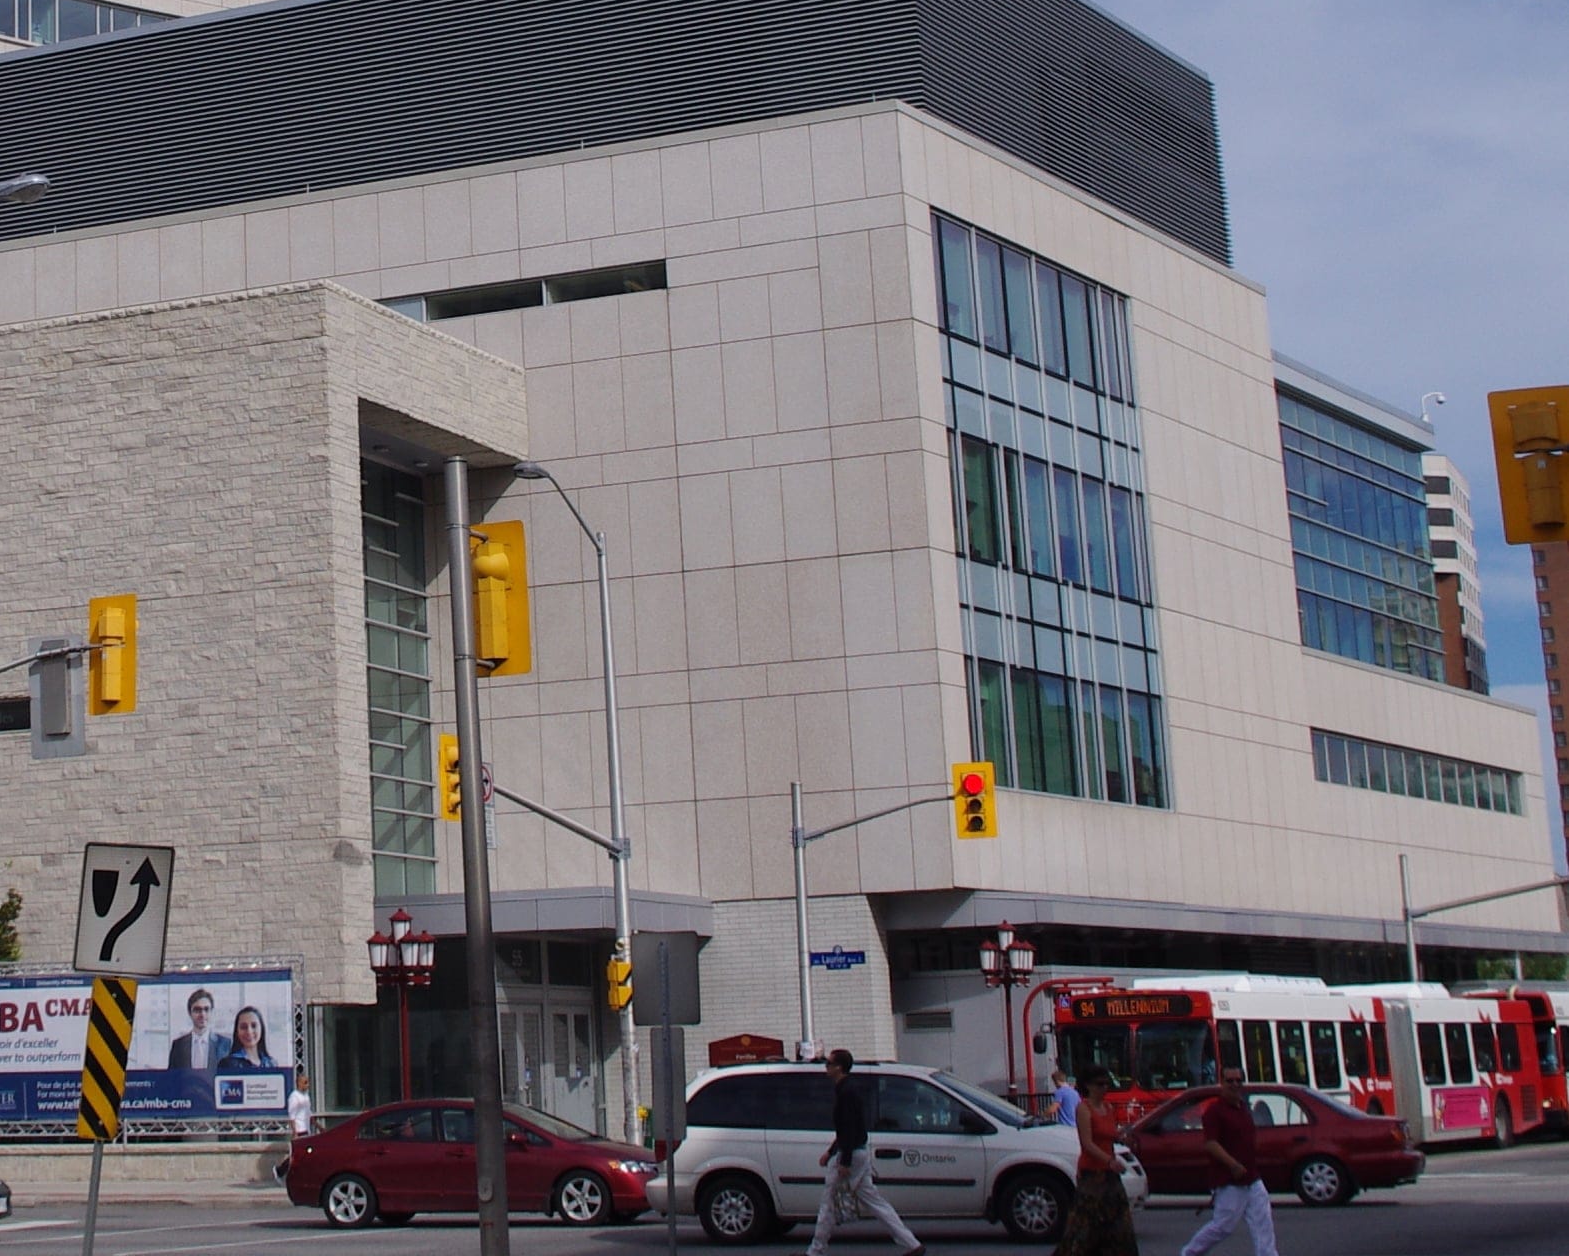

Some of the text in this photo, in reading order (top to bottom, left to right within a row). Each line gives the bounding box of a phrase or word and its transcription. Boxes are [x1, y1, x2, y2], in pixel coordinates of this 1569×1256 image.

[45, 998, 92, 1017] CMA
[1081, 999, 1169, 1017] 94 MILLENNIUM
[14, 1038, 59, 1049] d'exceller
[15, 1053, 24, 1063] to
[26, 1051, 81, 1063] outperform
[922, 1153, 957, 1163] Ontario
